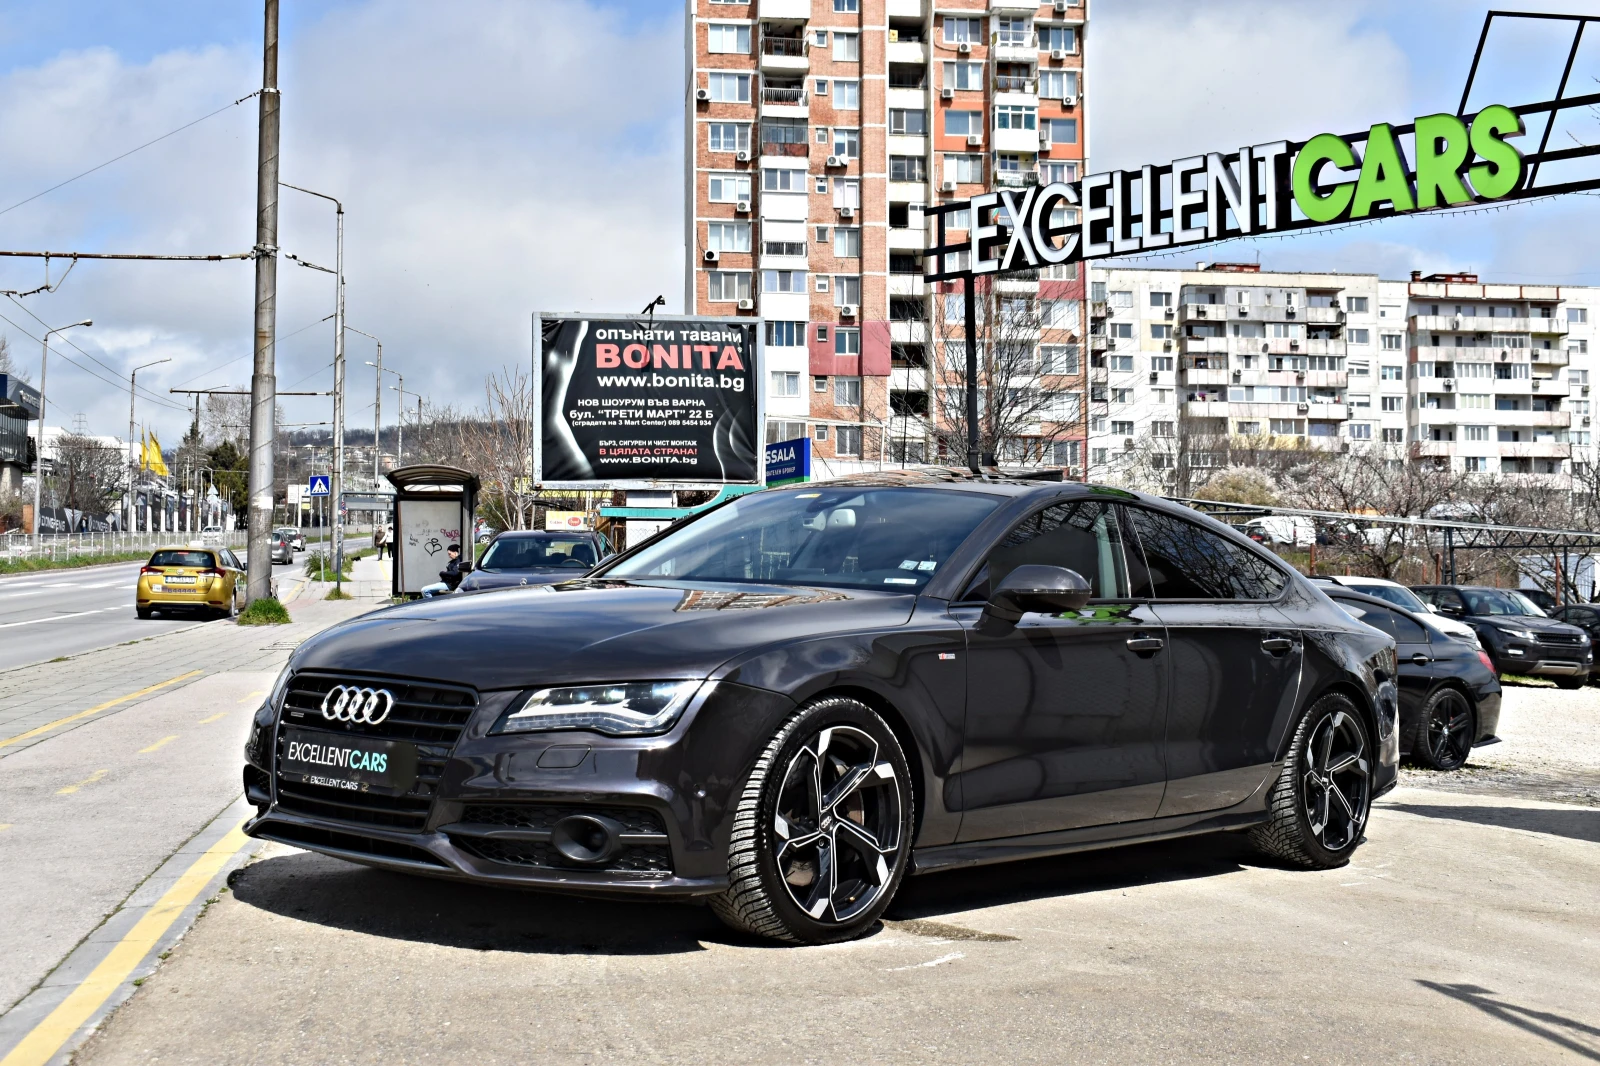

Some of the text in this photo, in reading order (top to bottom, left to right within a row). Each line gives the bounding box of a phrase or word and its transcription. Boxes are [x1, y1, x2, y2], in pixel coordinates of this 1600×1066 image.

[596, 329, 742, 343] опънати тавани
[597, 373, 745, 392] www.bonita.bg
[578, 399, 706, 407] НОВ ШОУРУМ ВЪВ ВАРНА
[569, 410, 595, 420] бул.
[689, 410, 702, 419] 22
[706, 410, 714, 419] Б
[609, 448, 651, 456] ЦЯЛАТА
[600, 456, 698, 464] www.BONITA.bg
[310, 775, 359, 790] EXCELLENT CARS
